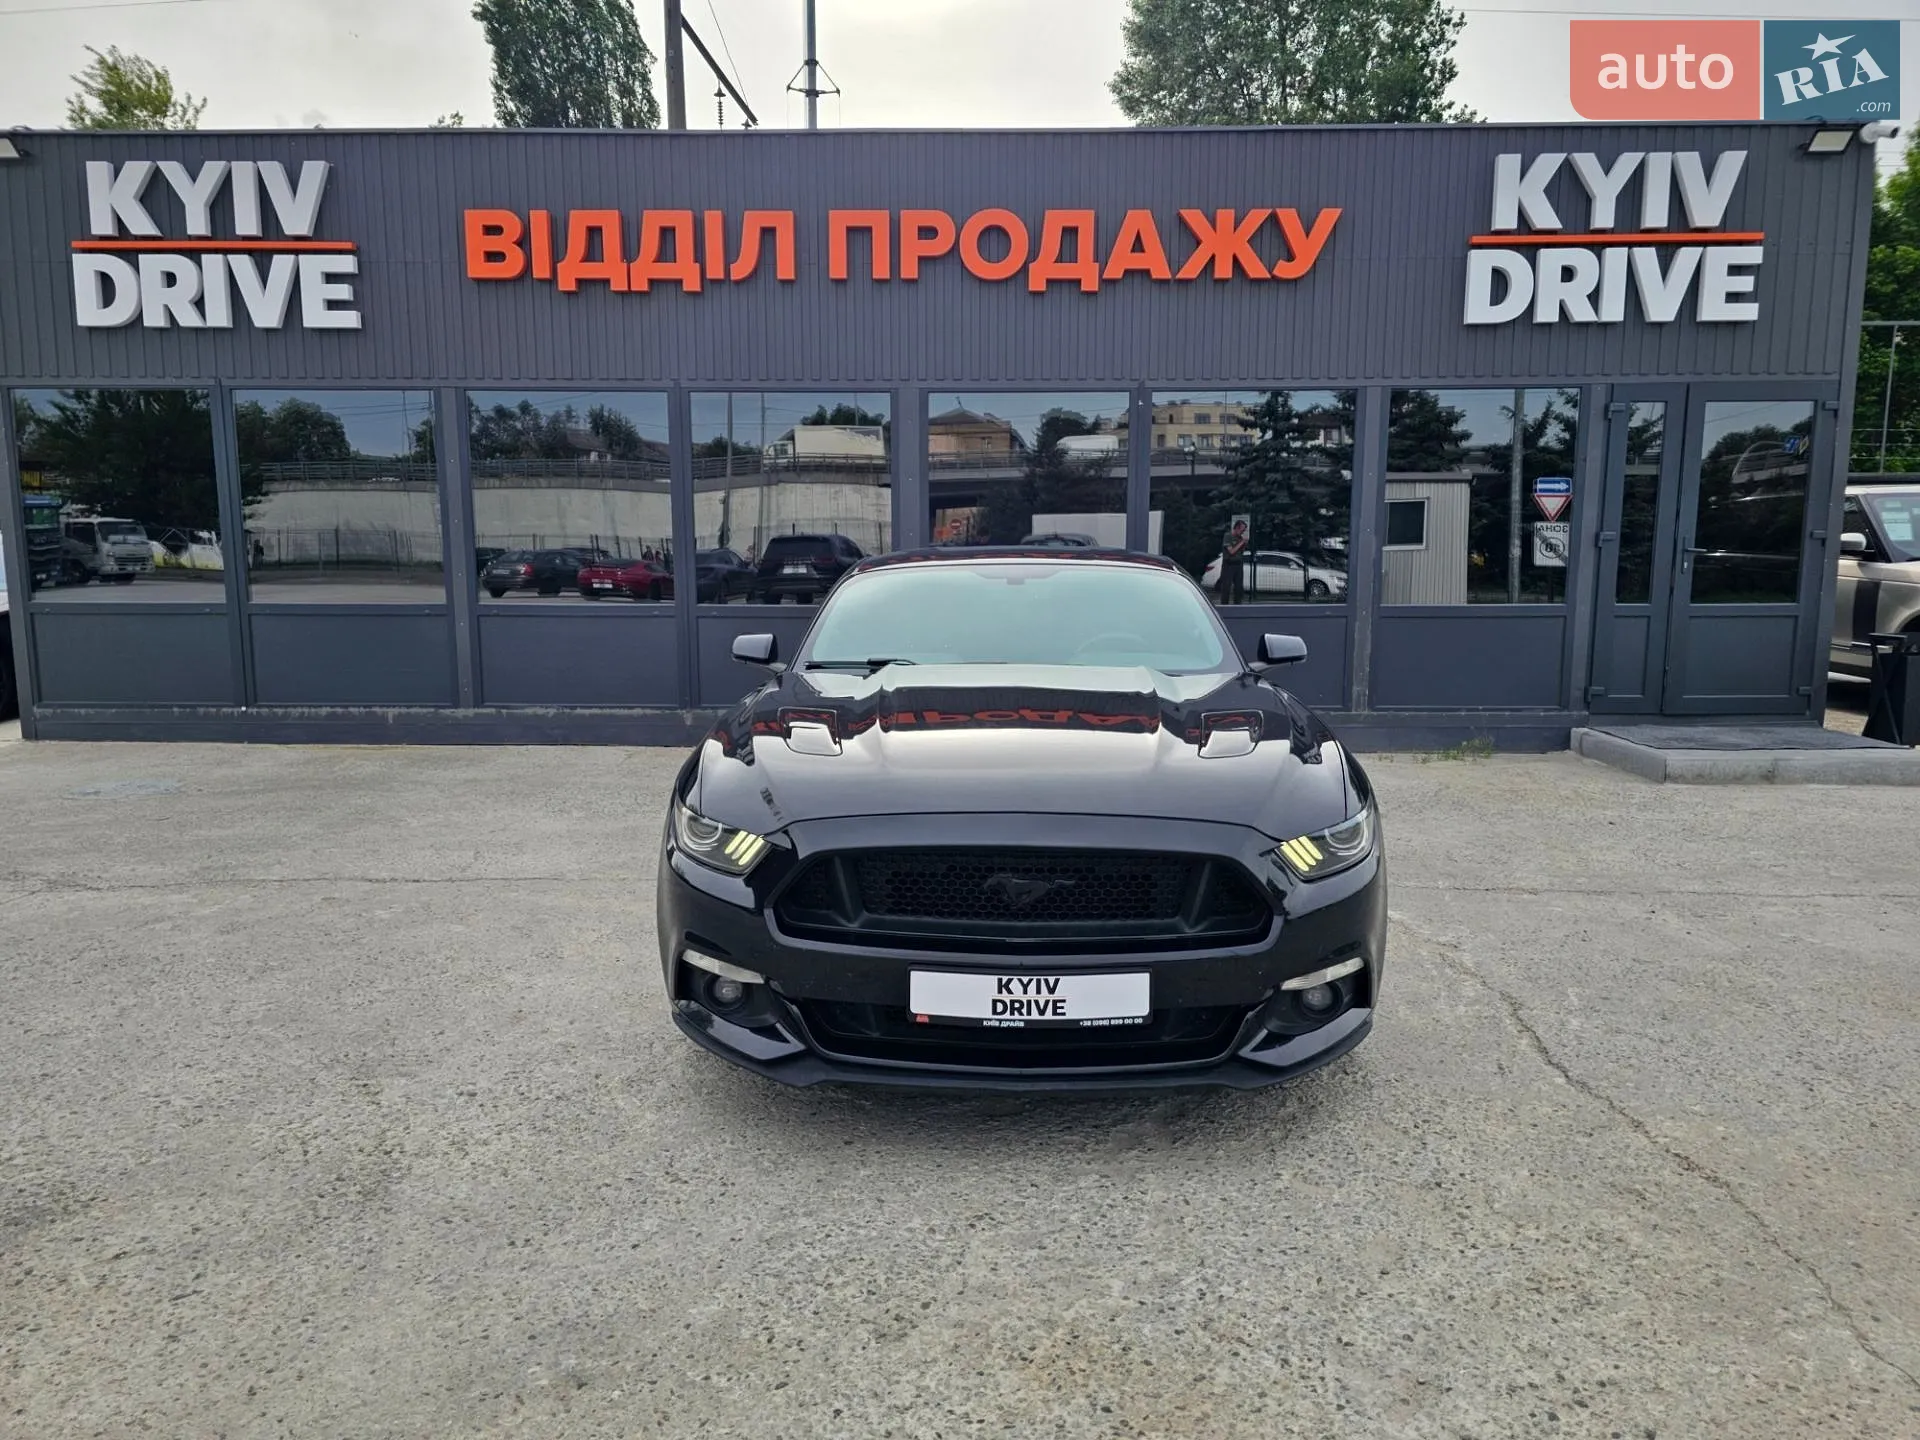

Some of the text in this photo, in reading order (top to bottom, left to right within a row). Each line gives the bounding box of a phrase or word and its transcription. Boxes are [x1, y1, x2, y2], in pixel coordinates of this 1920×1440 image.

[85, 160, 331, 237] KYIV
[1490, 150, 1748, 231] KYIV
[463, 207, 1343, 293] ВІДДІЛ ПРОДАЖУ
[1463, 245, 1764, 325] DRIVE
[72, 253, 363, 329] DRIVE
[991, 998, 1067, 1016] DRIVE
[996, 977, 1061, 995] KYIV
